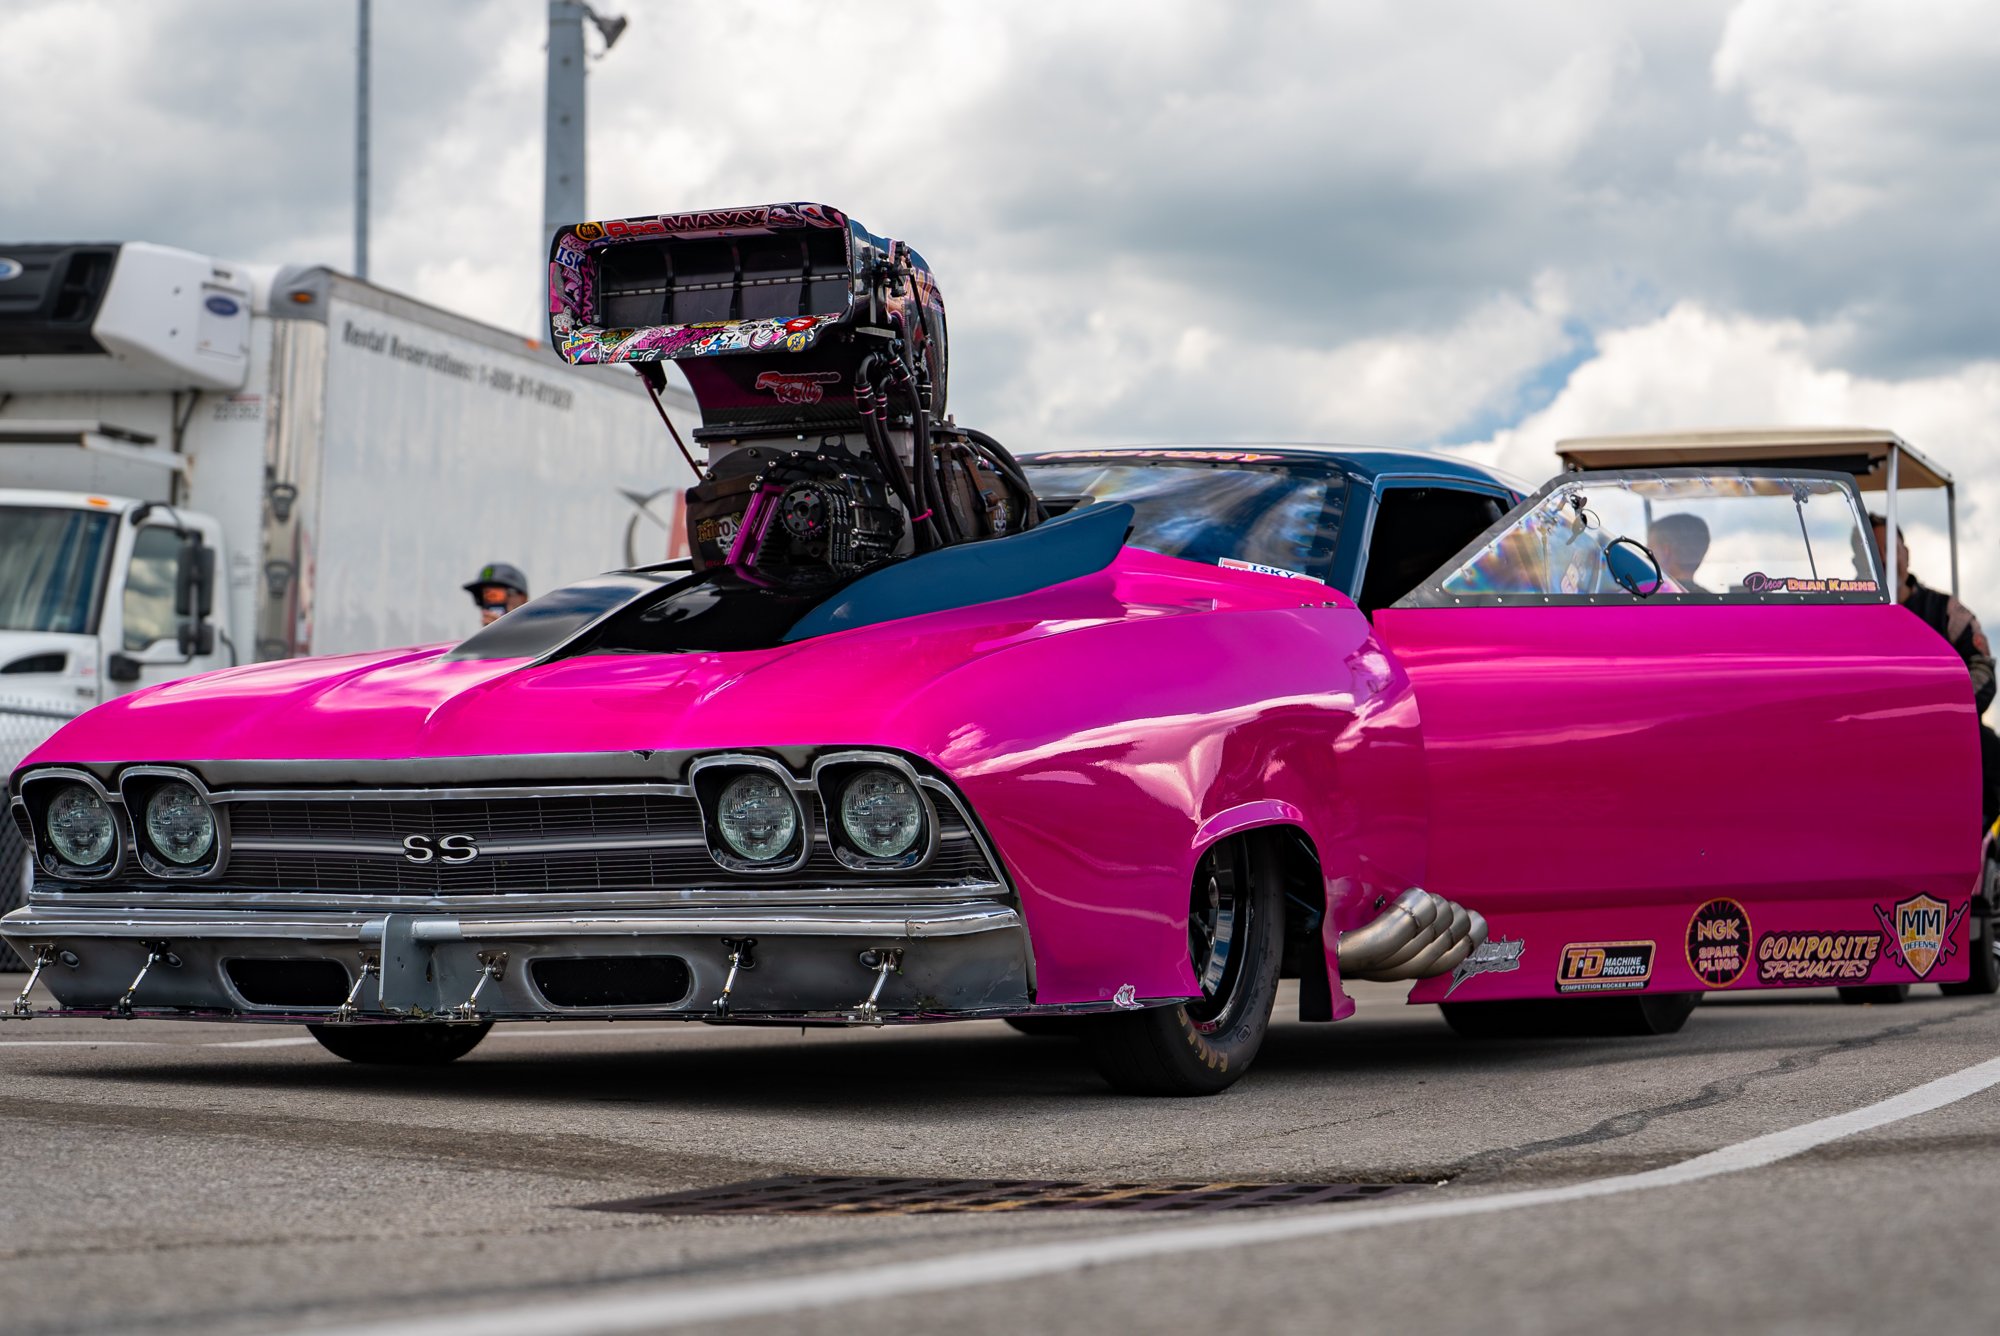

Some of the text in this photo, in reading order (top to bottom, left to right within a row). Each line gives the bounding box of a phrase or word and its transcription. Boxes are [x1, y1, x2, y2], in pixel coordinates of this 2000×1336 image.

[1251, 564, 1295, 579] ISKY
[1744, 572, 1783, 591] Disco
[402, 833, 478, 864] SS
[1698, 919, 1740, 941] NGK
[1901, 909, 1941, 936] MM
[1699, 945, 1740, 960] SPARK
[1759, 935, 1880, 961] COMPOSITE
[1903, 941, 1939, 951] DEFENSE
[1566, 949, 1643, 978] T&D MACHINE
[1602, 965, 1646, 976] PRODUCTS
[1699, 957, 1740, 972] PLUGS
[1761, 959, 1870, 979] SPECIALTIES
[1561, 983, 1601, 991] COMPETITION
